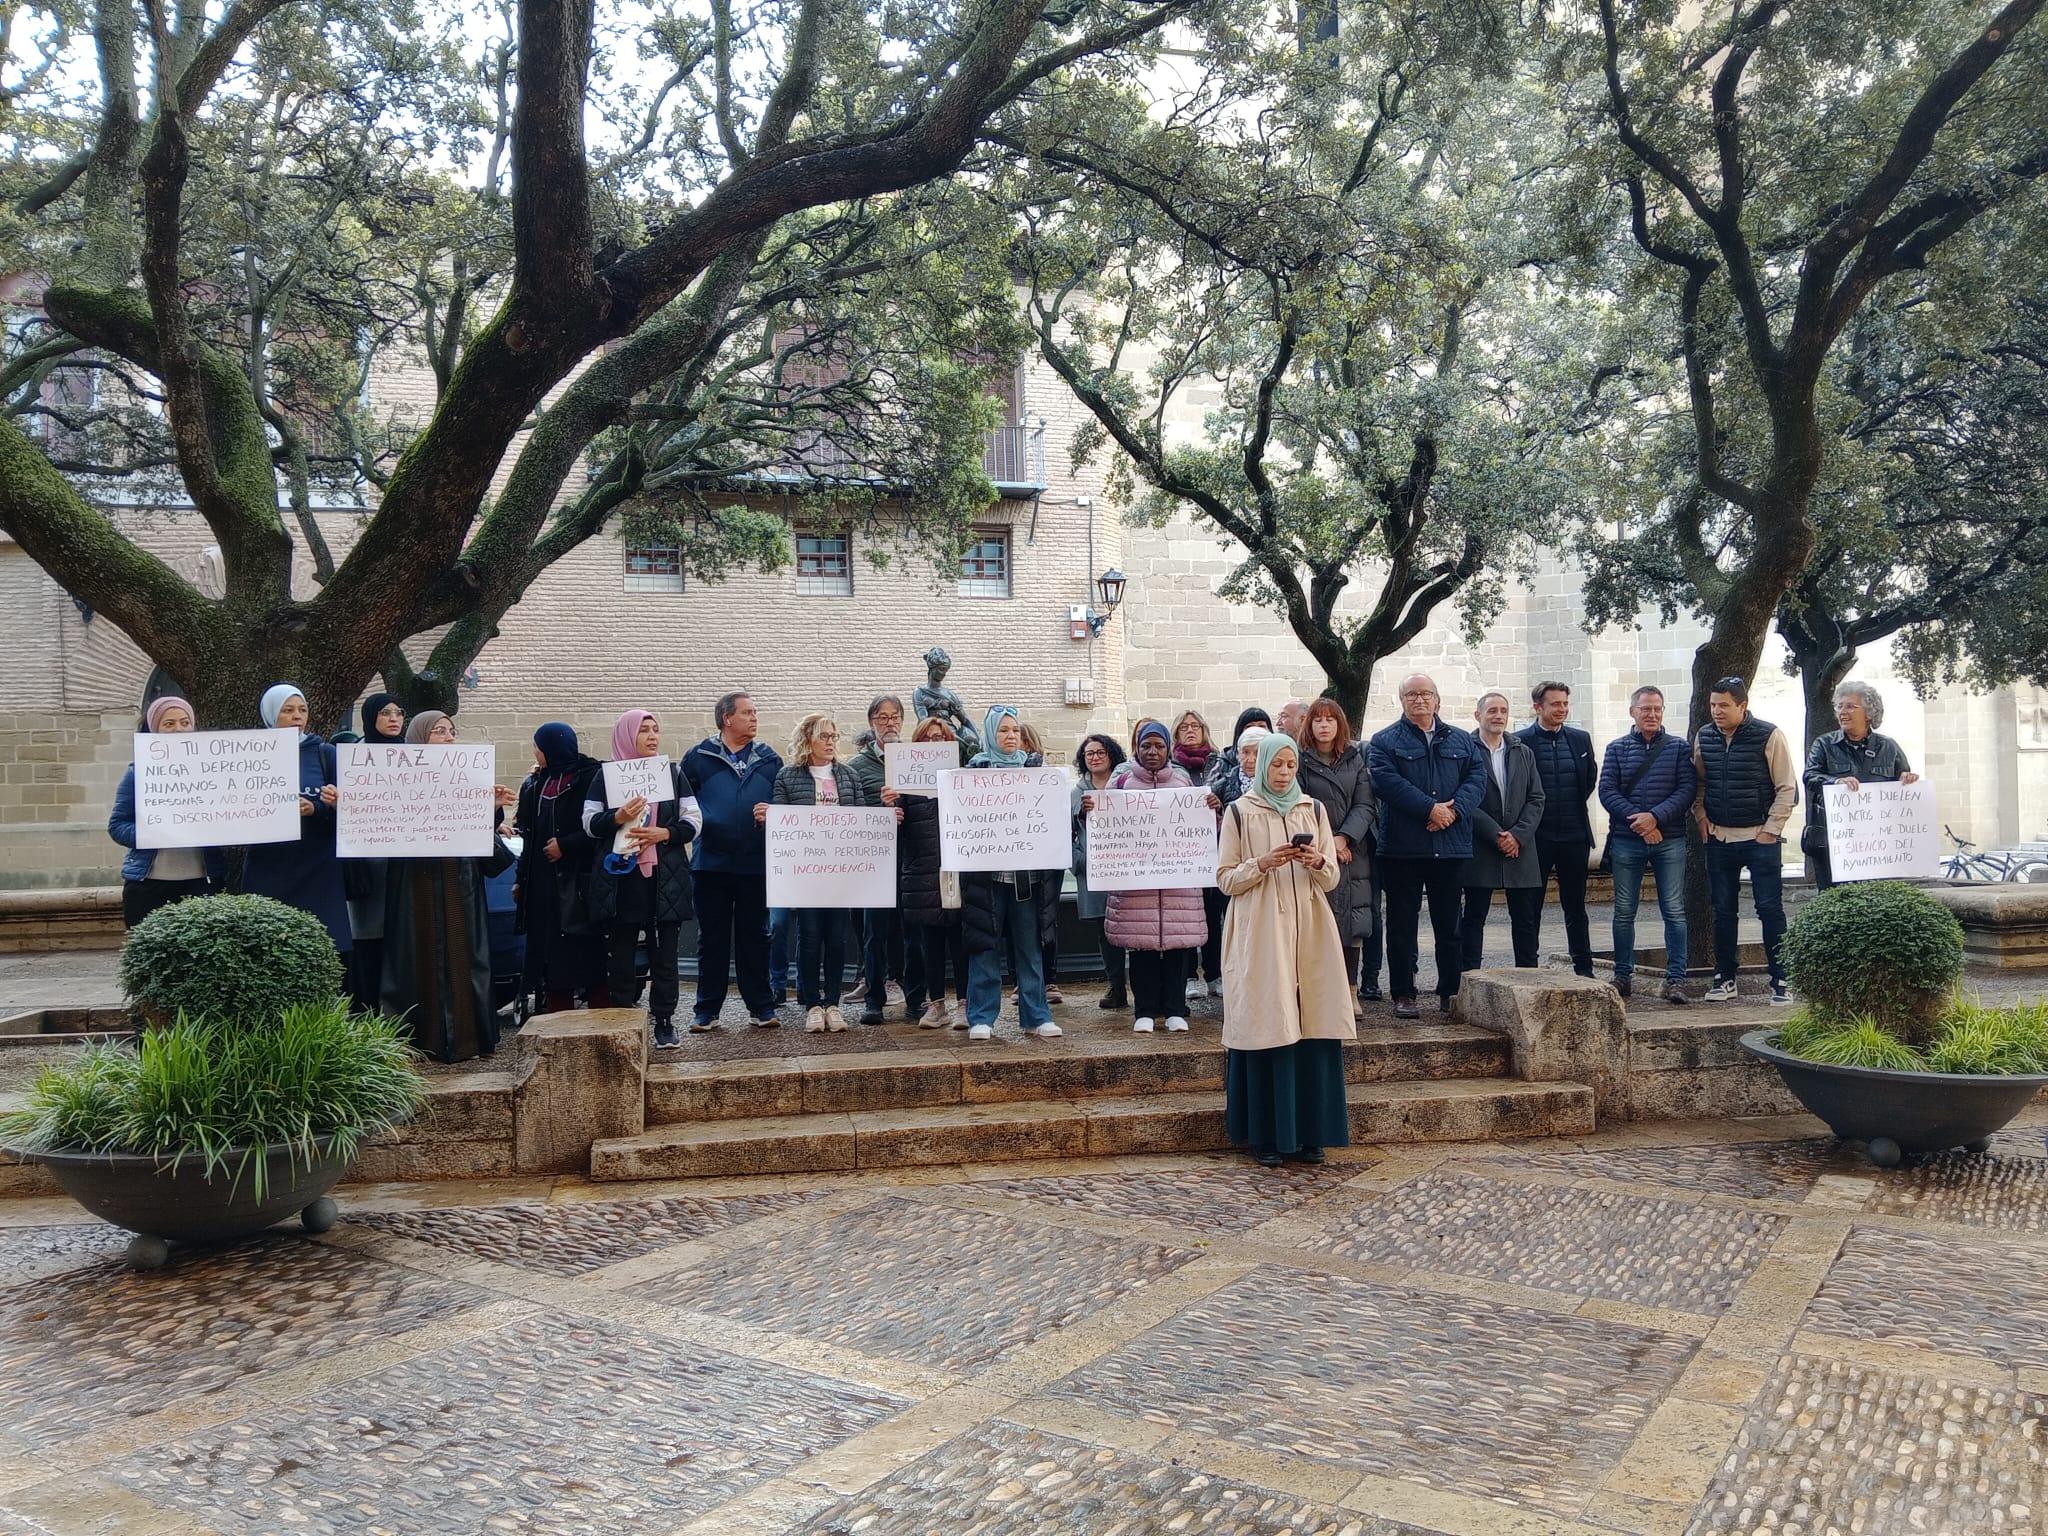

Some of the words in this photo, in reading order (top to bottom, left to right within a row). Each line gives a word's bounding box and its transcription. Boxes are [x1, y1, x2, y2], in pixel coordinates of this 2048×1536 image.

[150, 741, 169, 760] SI
[181, 741, 198, 755] TU
[897, 751, 905, 760] EL
[911, 749, 950, 762] RACISMO
[351, 748, 375, 766] LA
[386, 748, 429, 767] PAZ
[440, 751, 467, 768] NO
[472, 752, 490, 769] ES
[146, 764, 189, 777] NIEGA
[202, 760, 270, 773] DERECHOS
[617, 759, 649, 772] VIVE
[661, 761, 668, 771] Y
[910, 764, 924, 772] ES
[344, 771, 440, 786] SOLAMENTE
[450, 770, 469, 784] LA
[619, 773, 655, 785] DEJA
[899, 774, 936, 785] DELITO
[953, 776, 965, 789] EL
[973, 773, 1030, 788] RACISMO
[1039, 774, 1058, 785] ES
[145, 781, 217, 793] HUMANOS
[228, 778, 236, 790] A
[246, 777, 286, 790] OTRAS
[622, 784, 659, 799] VIVIR
[221, 795, 237, 804] NO
[244, 793, 256, 803] ES
[343, 791, 401, 802] AUSENCIA
[410, 790, 425, 800] DE
[430, 785, 446, 798] LA
[958, 792, 1025, 806] VIOLENCIA
[1034, 794, 1044, 806] Y
[1833, 793, 1850, 807] NO
[1859, 792, 1872, 804] ME
[1880, 789, 1921, 801] DUELEN
[1098, 794, 1115, 811] LA
[1125, 792, 1159, 811] PAZ
[1170, 792, 1192, 808] NO
[341, 805, 395, 815] MIENTRAS
[402, 804, 430, 815] HAYA
[1831, 812, 1842, 823] LOS
[1849, 810, 1873, 822] ACTOS
[1881, 809, 1891, 818] DE
[1900, 808, 1913, 817] LA
[148, 814, 161, 825] ES
[780, 815, 798, 826] NO
[810, 814, 857, 826] PROTESTO
[866, 814, 891, 825] PARA
[946, 813, 962, 824] LA
[1027, 810, 1044, 818] ES
[1090, 814, 1156, 829] SOLAMENTE
[1170, 811, 1185, 824] LA
[1006, 827, 1019, 835] DE
[1027, 822, 1048, 833] LOS
[1091, 830, 1134, 840] AUSENCIA
[1140, 830, 1151, 838] DE
[1157, 827, 1167, 837] LA
[1175, 826, 1212, 838] GUERRA
[1880, 826, 1893, 835] ME
[1899, 824, 1928, 833] DUELE
[364, 835, 395, 845] MUNDO
[772, 831, 815, 841] AFECTAR
[821, 830, 834, 839] TU
[840, 831, 894, 840] COMODIDAD
[773, 848, 796, 858] SINO
[804, 848, 826, 856] PARA
[835, 847, 890, 856] PERTURBAR
[958, 842, 1034, 858] IGNORANTES
[1090, 842, 1128, 851] MIENTRAS
[1135, 841, 1158, 849] HAYA
[1846, 840, 1886, 853] SILENCIO
[1896, 839, 1916, 848] DEL
[1151, 853, 1157, 861] Y
[1844, 853, 1913, 871] AYUNTAMIENTO
[773, 866, 782, 874] TU
[792, 863, 876, 874] INCONSCIENCIA
[1091, 870, 1129, 878] ALCANZAR
